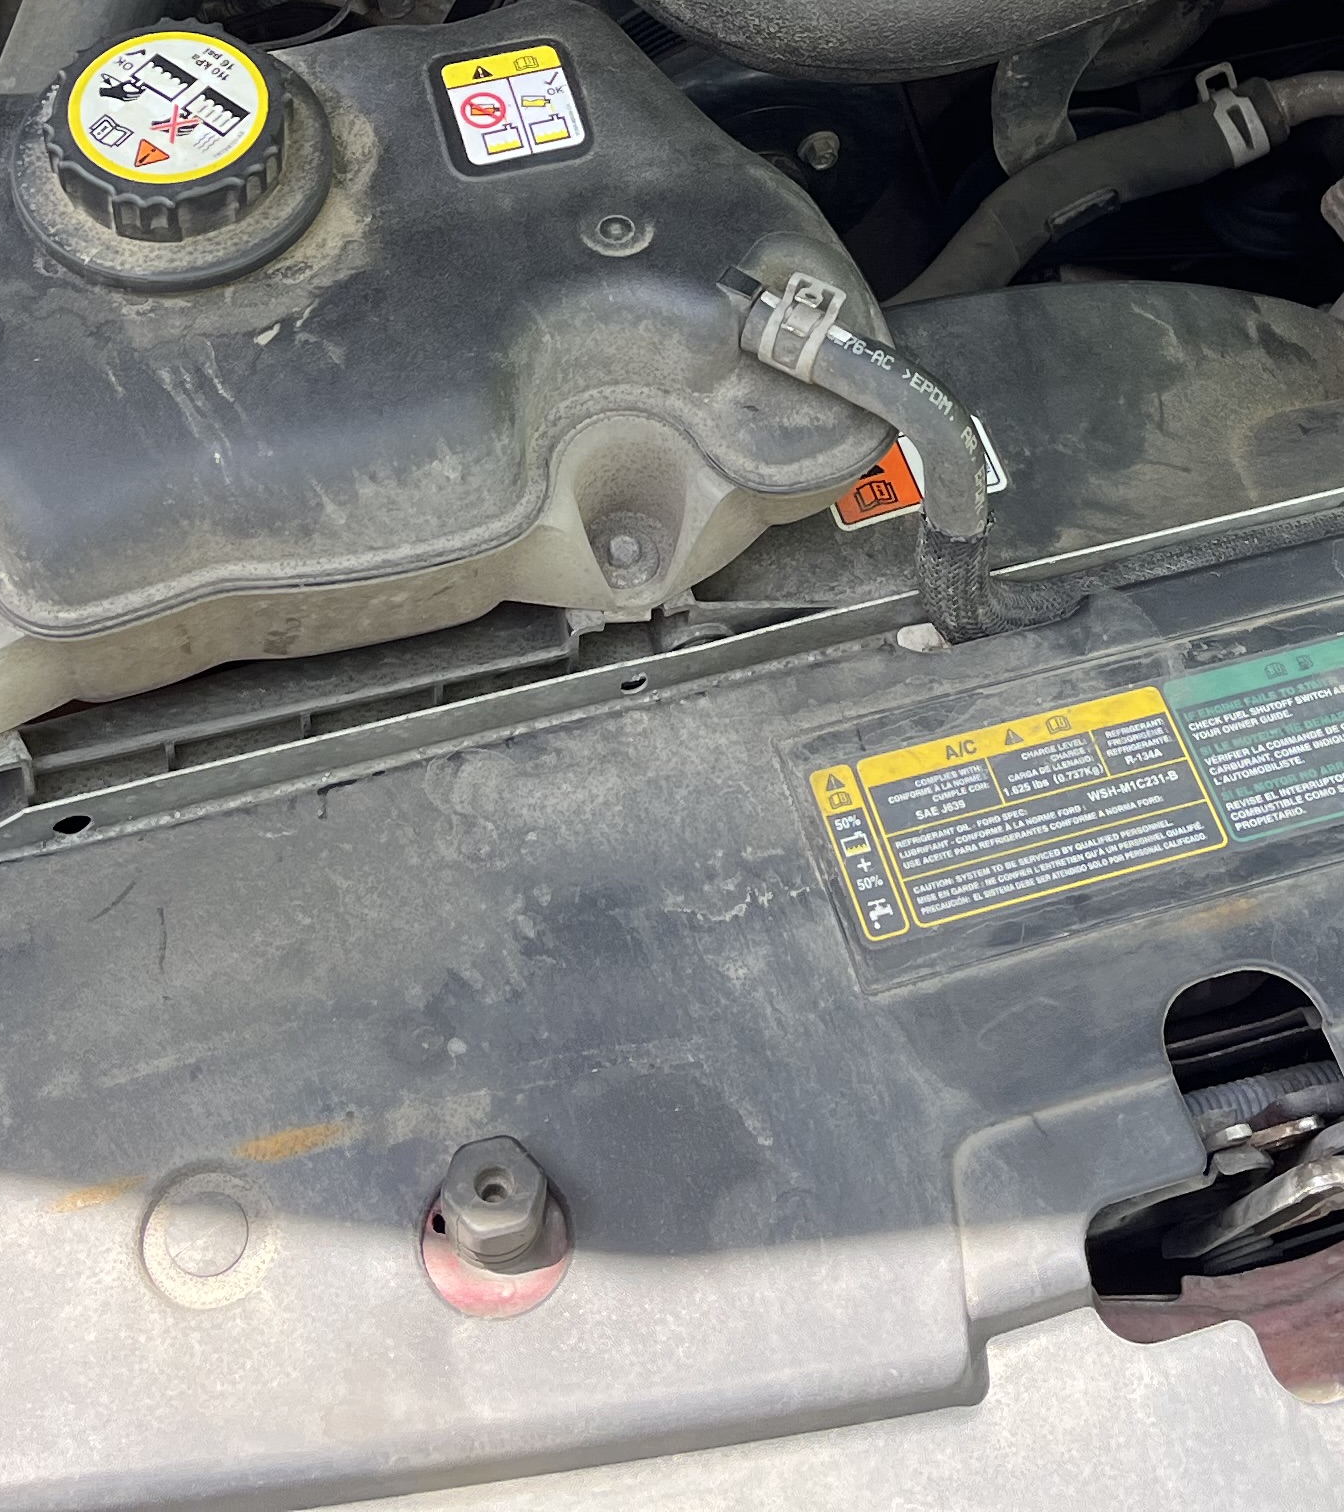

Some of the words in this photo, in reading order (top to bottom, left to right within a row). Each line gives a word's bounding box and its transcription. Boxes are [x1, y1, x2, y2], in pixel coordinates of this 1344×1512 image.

[115, 55, 134, 72] OK
[191, 52, 211, 70] kPa
[202, 47, 222, 61] psi
[546, 85, 564, 95] OK
[1183, 711, 1196, 722] IF
[1197, 699, 1243, 718] ENGINE
[1243, 690, 1277, 706] FAILS
[1278, 685, 1297, 697] TO
[1187, 716, 1223, 733] CHECK
[1222, 709, 1250, 723] FUEL
[1248, 697, 1294, 716] SHUTOFF
[1293, 687, 1333, 704] SWITCH
[1192, 727, 1221, 741] YOUR
[1221, 717, 1259, 734] OWNER
[1258, 708, 1292, 724] GUIDE.
[941, 738, 979, 761] A/C
[1199, 745, 1214, 757] SI
[1214, 741, 1231, 753] LE
[1284, 722, 1303, 735] NE
[1250, 743, 1266, 754] LA
[1264, 727, 1324, 750] COMMANDE
[1323, 723, 1340, 735] DE
[1272, 741, 1312, 760] COMME
[1020, 744, 1057, 761] CHARGE
[1049, 747, 1085, 762] CHARGE
[1123, 747, 1163, 766] R-134A
[913, 769, 958, 788] COMPLIES
[1007, 768, 1039, 783] CARGA
[1037, 764, 1051, 774] DE
[1086, 769, 1179, 802] WSH-M1C231-B
[1220, 791, 1235, 802] SI
[1236, 786, 1253, 798] EL
[1253, 774, 1298, 793] MOTOR
[1298, 768, 1318, 781] NO
[887, 785, 933, 805] CONFORME
[932, 783, 941, 793] À
[940, 780, 953, 791] LA
[931, 786, 967, 803] CUMPLE
[1002, 781, 1033, 800] 1.625
[1030, 776, 1051, 792] lbs
[914, 805, 940, 821] SAE
[939, 798, 966, 814] J639
[1224, 794, 1264, 812] REVISE
[1263, 790, 1279, 802] EL
[1229, 794, 1305, 823] COMBUSTIBLE
[1303, 785, 1338, 803] COMO
[833, 813, 862, 832] 50%
[1234, 805, 1307, 832] PROPIETARIO.
[894, 826, 956, 849] REFRIGERANT
[955, 822, 971, 833] OIL
[976, 814, 1001, 827] FORD
[898, 839, 950, 859] LUBRIFIANT
[954, 824, 1004, 844] CONFORME
[1003, 822, 1012, 831] À
[1011, 819, 1025, 829] LA
[1056, 803, 1081, 817] FORD
[902, 858, 922, 870] USE
[921, 849, 954, 865] ACEITE
[953, 843, 978, 856] PARA
[977, 824, 1049, 849] REFRIGERANTES
[1048, 811, 1098, 830] CONFORME
[1096, 809, 1105, 817] A
[1104, 800, 1137, 815] NORMA
[937, 889, 951, 899] EN
[949, 881, 980, 896] GARDE
[984, 876, 997, 887] NE
[1104, 843, 1118, 854] UN
[1117, 830, 1166, 850] PERSONNEL
[954, 866, 991, 883] SYSTEM
[990, 863, 1004, 873] TO
[1003, 859, 1018, 869] BE
[1017, 847, 1061, 866] SERVICED
[1060, 844, 1075, 854] BY
[1073, 831, 1120, 850] QUALIFIED
[855, 872, 884, 892] 50%
[971, 891, 983, 902] EL
[982, 882, 1016, 899] SISTEMA
[1014, 877, 1036, 890] DEBE
[1034, 872, 1052, 884] SER
[1107, 852, 1125, 864] POR
[1123, 842, 1164, 860] PERSONAL
